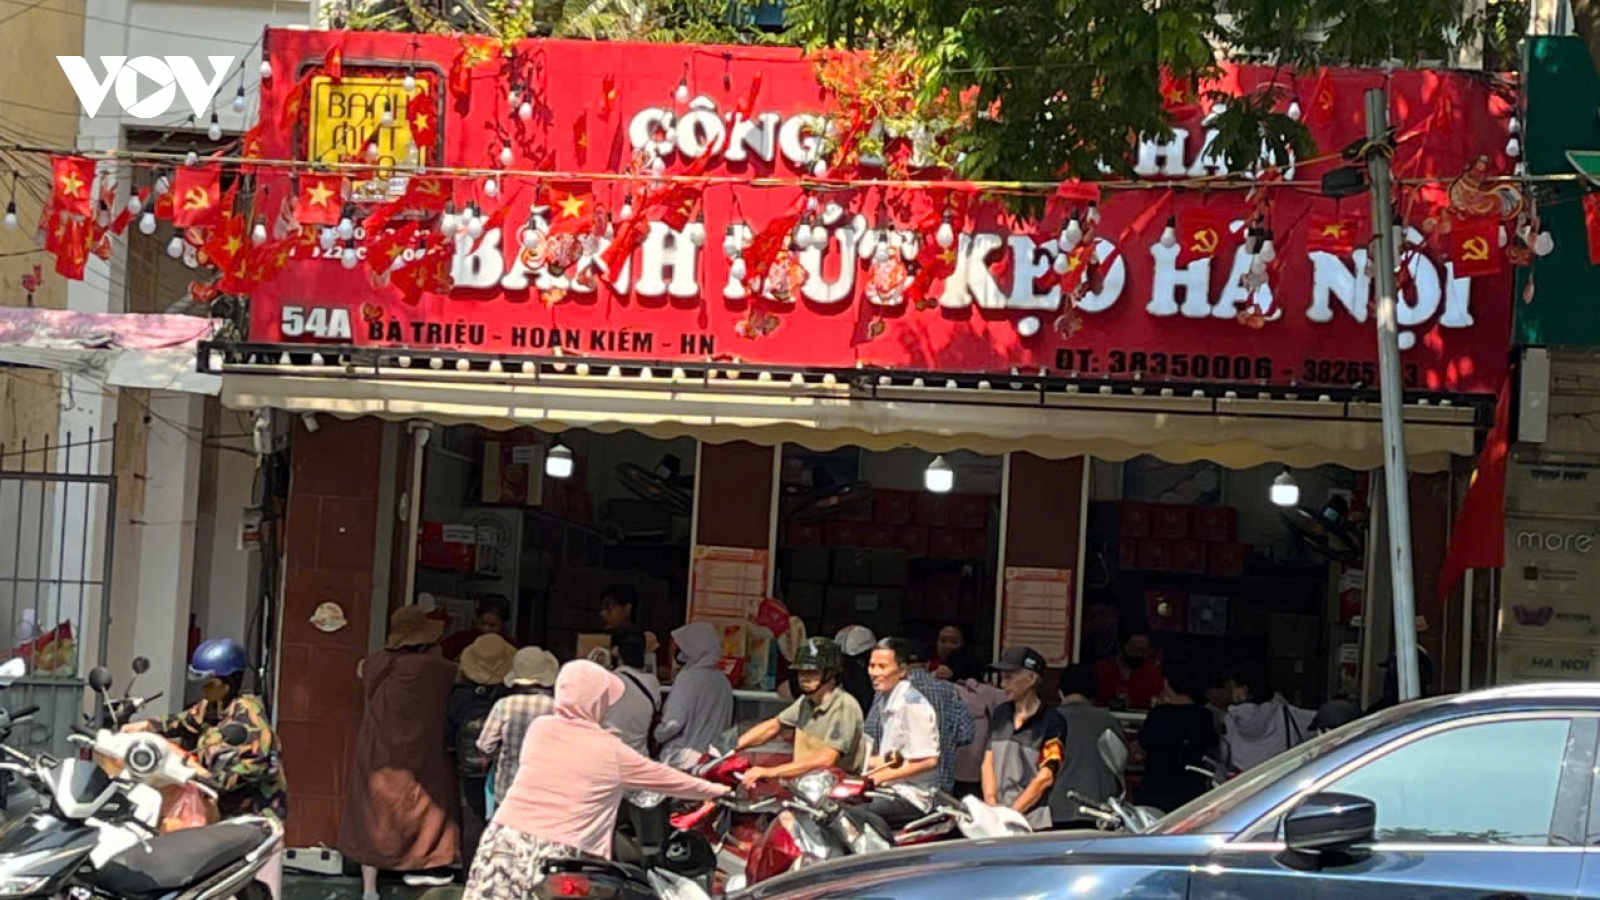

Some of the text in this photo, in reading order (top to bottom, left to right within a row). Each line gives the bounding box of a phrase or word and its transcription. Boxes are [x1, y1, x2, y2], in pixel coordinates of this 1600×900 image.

[628, 95, 828, 164] CÔNG
[938, 232, 1126, 337] KẸO
[1145, 219, 1282, 319] HÀ
[1305, 226, 1474, 350] NỘI
[281, 306, 351, 339] 54A
[410, 318, 485, 349] TRIỆU
[681, 333, 714, 354] HN
[1109, 351, 1273, 379] 38350006
[1303, 358, 1418, 388] 382653
[1517, 531, 1594, 553] more
